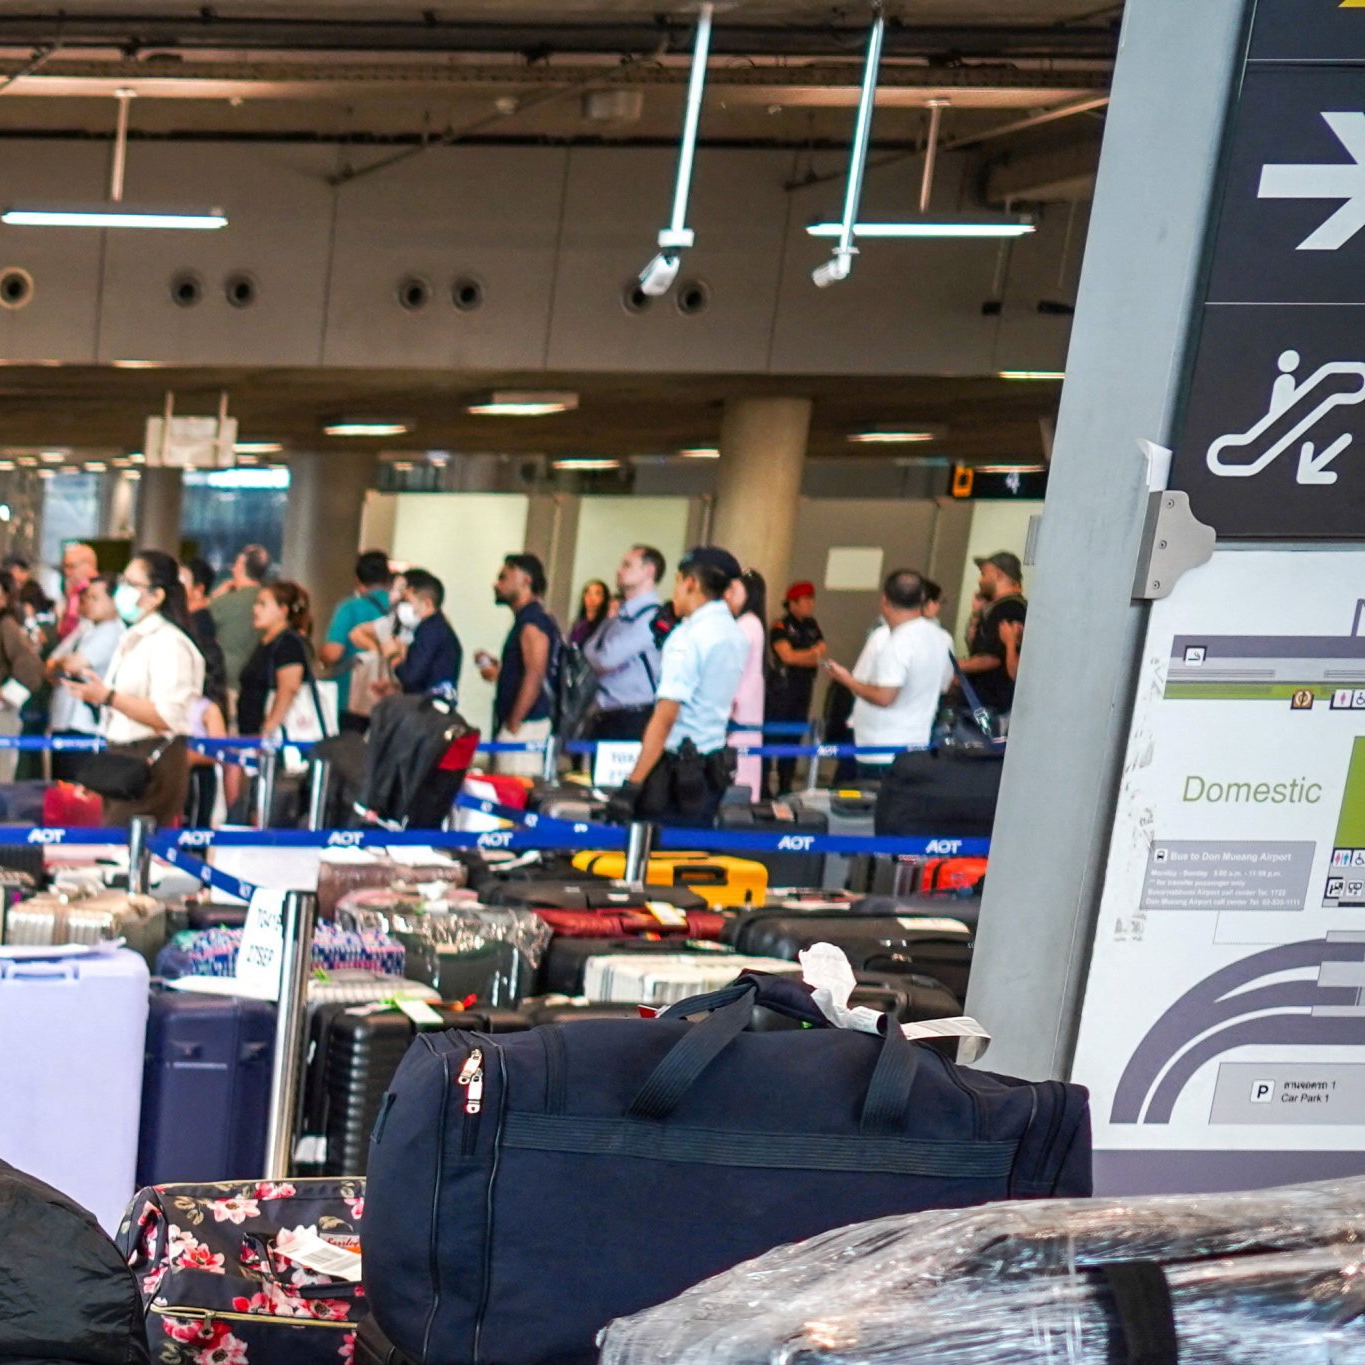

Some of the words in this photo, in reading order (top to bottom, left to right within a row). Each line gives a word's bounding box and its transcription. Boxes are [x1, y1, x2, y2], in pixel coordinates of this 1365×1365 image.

[1183, 776, 1322, 803] Domestic
[28, 828, 66, 844] AOT
[178, 830, 216, 846] AOT
[327, 830, 364, 846] AOT
[477, 832, 514, 848] AOT
[778, 836, 815, 851] AOT
[925, 839, 962, 855] AOT
[1171, 853, 1189, 861] Bus
[1191, 853, 1200, 861] to
[1202, 853, 1221, 861] Don
[1260, 853, 1292, 863] Airport
[1281, 1093, 1298, 1103] Car
[1300, 1093, 1322, 1103] Park
[1324, 1094, 1330, 1103] 1
